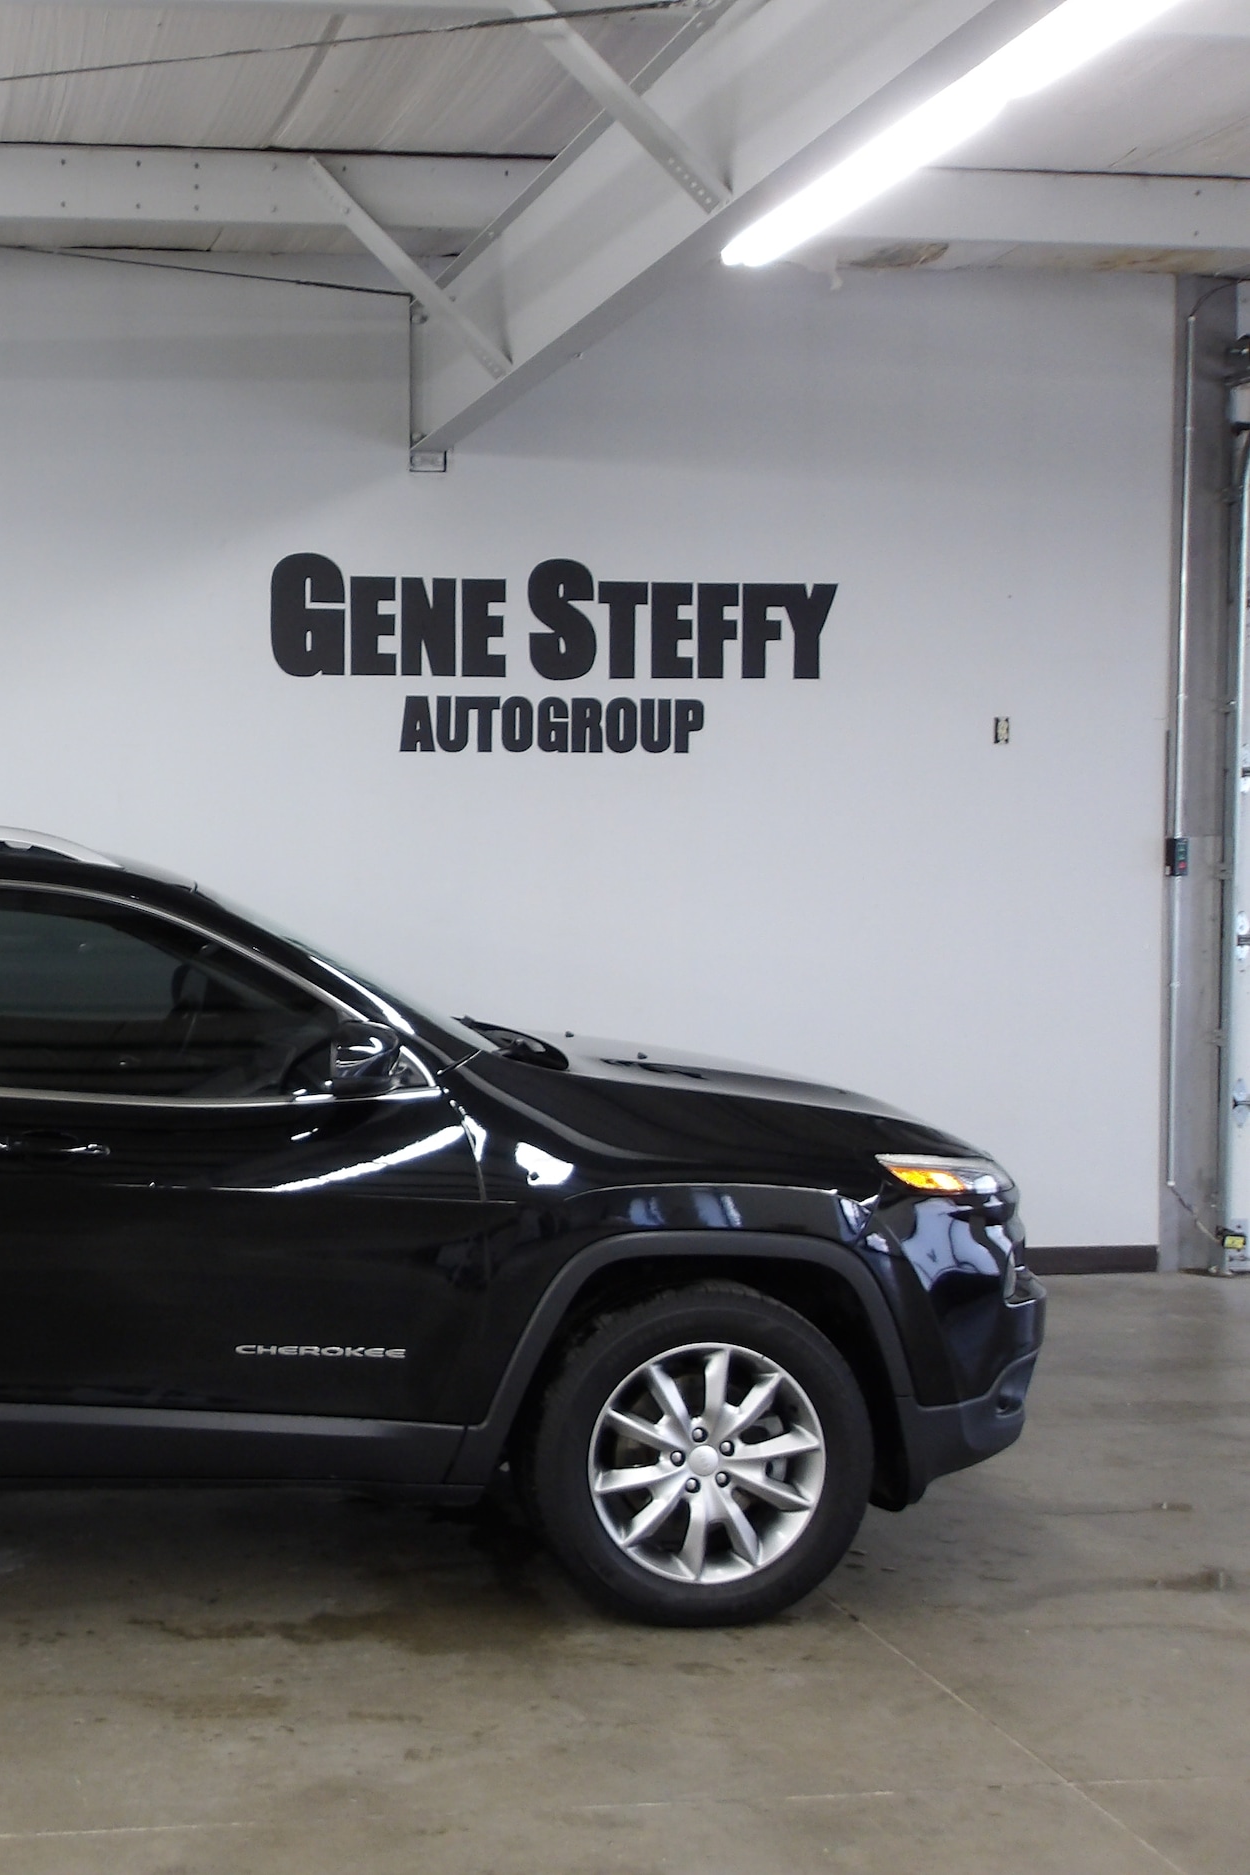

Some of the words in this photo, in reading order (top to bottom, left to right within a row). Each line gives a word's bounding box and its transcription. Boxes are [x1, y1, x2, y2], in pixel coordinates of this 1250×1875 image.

[270, 553, 507, 678] GENE
[527, 558, 839, 681] STEFFY
[399, 695, 705, 754] AUTOGROUP
[235, 1344, 407, 1359] CHEROKEE
